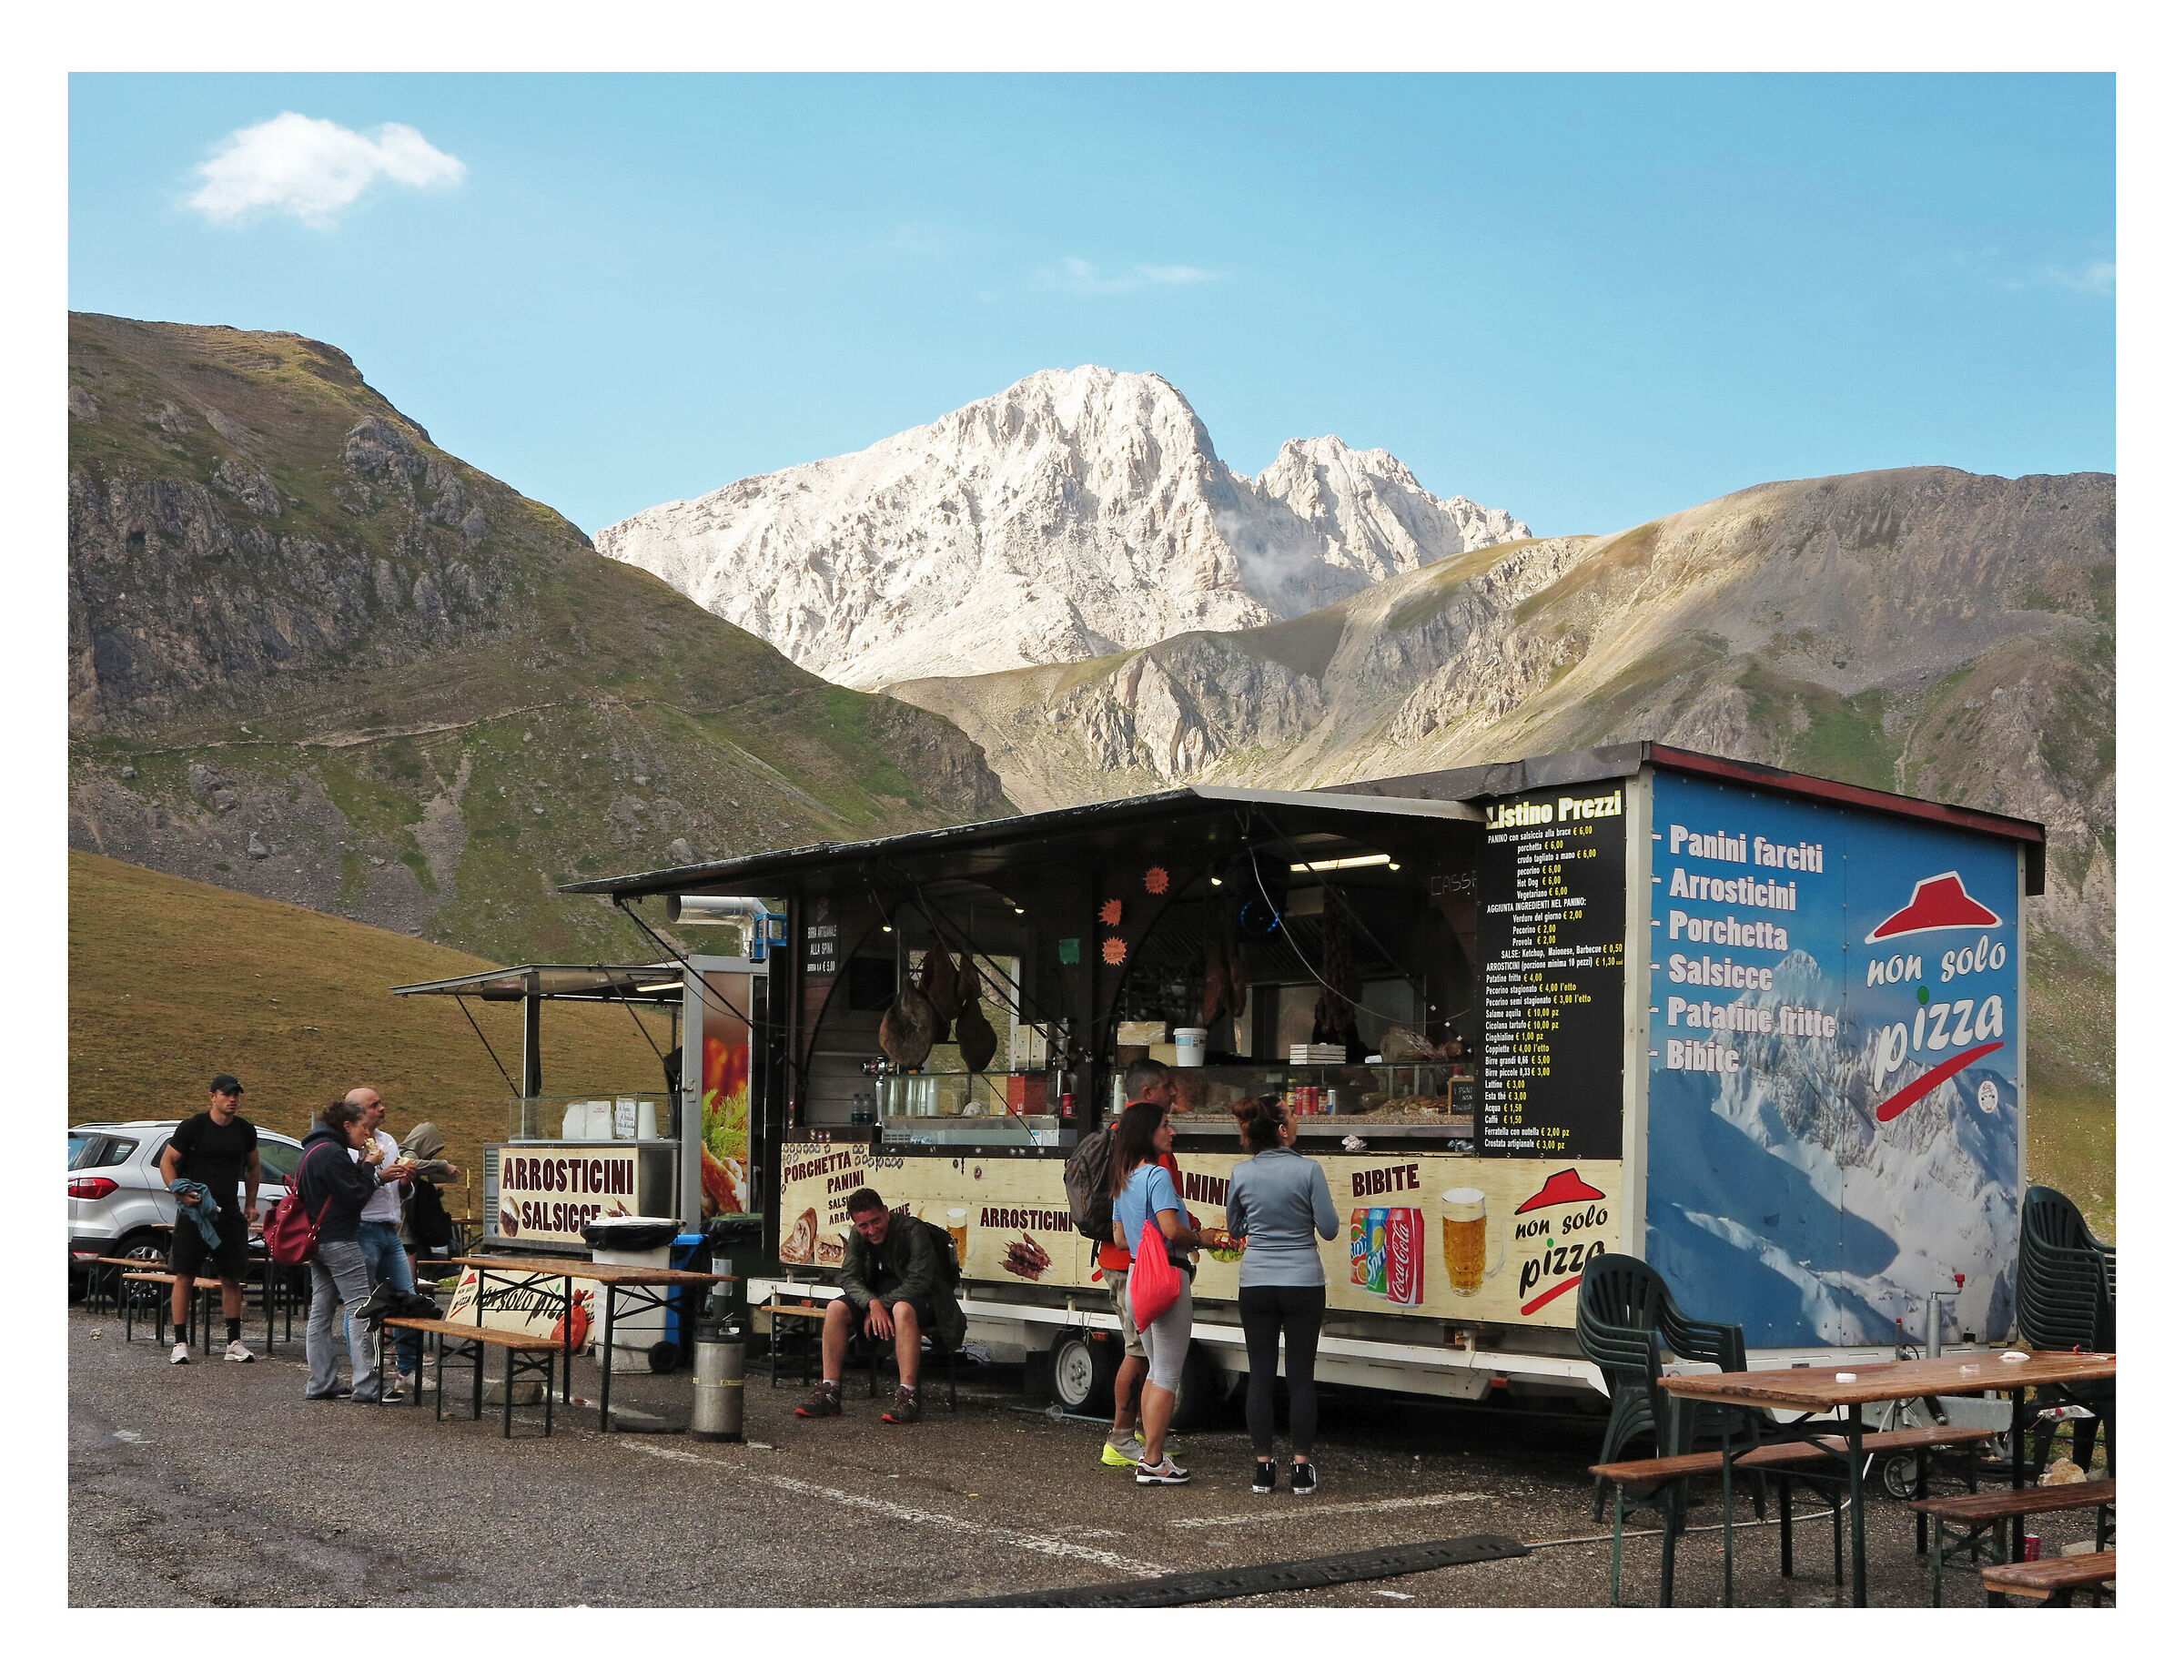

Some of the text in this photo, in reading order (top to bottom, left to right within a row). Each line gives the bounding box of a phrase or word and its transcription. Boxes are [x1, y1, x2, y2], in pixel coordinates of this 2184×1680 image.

[1486, 790, 1622, 830] Listino Prezzi
[1488, 834, 1508, 844] PANINO
[1521, 830, 1543, 840] salsiccia
[1545, 829, 1555, 837] alla
[1557, 828, 1572, 836] brace
[1572, 827, 1578, 835] €
[1579, 825, 1593, 836] 6,00
[1518, 840, 1564, 855] porchetta 6,00
[1670, 824, 1824, 874] Panini farciti
[1518, 854, 1532, 864] crudo
[1534, 853, 1554, 864] tagliato
[1576, 850, 1582, 858] €
[1582, 849, 1597, 859] 6,00
[1517, 865, 1562, 877] pecorino 6,00
[1517, 879, 1527, 887] Hot
[1528, 878, 1539, 887] Dog
[1548, 875, 1562, 886] 6,00
[1517, 886, 1568, 900] Vegetariano € 6,00
[1670, 868, 1797, 912] Arrosticini
[1487, 903, 1514, 913] AGGIUNTA
[1516, 900, 1550, 911] INGREDIENTI
[1552, 899, 1562, 907] NEL
[1513, 910, 1582, 923] Verdure del giorno 2,00
[1513, 926, 1536, 935] Pecorino
[1542, 925, 1557, 934] 2,00
[1669, 911, 1788, 951] Porchetta
[1512, 936, 1556, 946] Provola € 2,00
[1502, 950, 1521, 958] SALSE:
[1522, 948, 1546, 958] Ketchup,
[1577, 945, 1603, 954] Barbecue
[1603, 945, 1607, 953] €
[1609, 944, 1623, 954] 0,50
[1486, 962, 1521, 971] ARROSTICINI
[1522, 960, 1546, 971] (porzione
[1548, 959, 1567, 967] minima
[1568, 958, 1575, 967] 10
[1595, 957, 1600, 966] €
[1602, 956, 1617, 967] 1,30
[1867, 934, 2007, 988] non solo
[1486, 973, 1542, 983] Patatine fritte 4,00
[1668, 953, 1774, 991] Salsicce
[1486, 983, 1577, 995] Pecorino stagionato € 4,00 l'etto
[1486, 995, 1592, 1007] Pecorino semi stagionato € 3,00 l'etto
[1486, 1008, 1559, 1019] Salame aquila € 10,00 pz
[1667, 996, 1835, 1038] Patatine fritte
[1510, 1020, 1527, 1028] tartufo
[1527, 1021, 1532, 1029] €
[1533, 1020, 1550, 1030] 10,00
[1552, 1022, 1559, 1031] pz
[1515, 1032, 1520, 1040] €
[1522, 1032, 1534, 1041] 1,00
[1536, 1034, 1543, 1043] pz
[1874, 987, 2004, 1092] pizza
[1485, 1044, 1550, 1055] Coppiette € 4,00 l'etto
[1666, 1039, 1740, 1073] Bibite
[1485, 1056, 1551, 1067] Birre grandi 0,66 € 5,00
[1485, 1068, 1551, 1078] Birre piccole 0,33 € 3,00
[1485, 1080, 1525, 1089] Lattine € 3,00
[1508, 1092, 1512, 1100] €
[1513, 1092, 1527, 1101] 3,00
[1485, 1104, 1522, 1114] Acqua € 1,50
[1510, 1116, 1522, 1125] 1,50
[1522, 1128, 1540, 1136] nutella
[1541, 1128, 1545, 1136] €
[1547, 1128, 1560, 1137] 2,00
[1562, 1129, 1569, 1139] pz
[1485, 1139, 1564, 1151] Crostata artigianale € 3,00 pz
[784, 1150, 852, 1184] PORCHETTA
[502, 1158, 634, 1195] ARROSTICINI
[827, 1169, 864, 1194] PANINI
[1351, 1163, 1421, 1198] BIBITE
[1515, 1204, 1609, 1240] non solo
